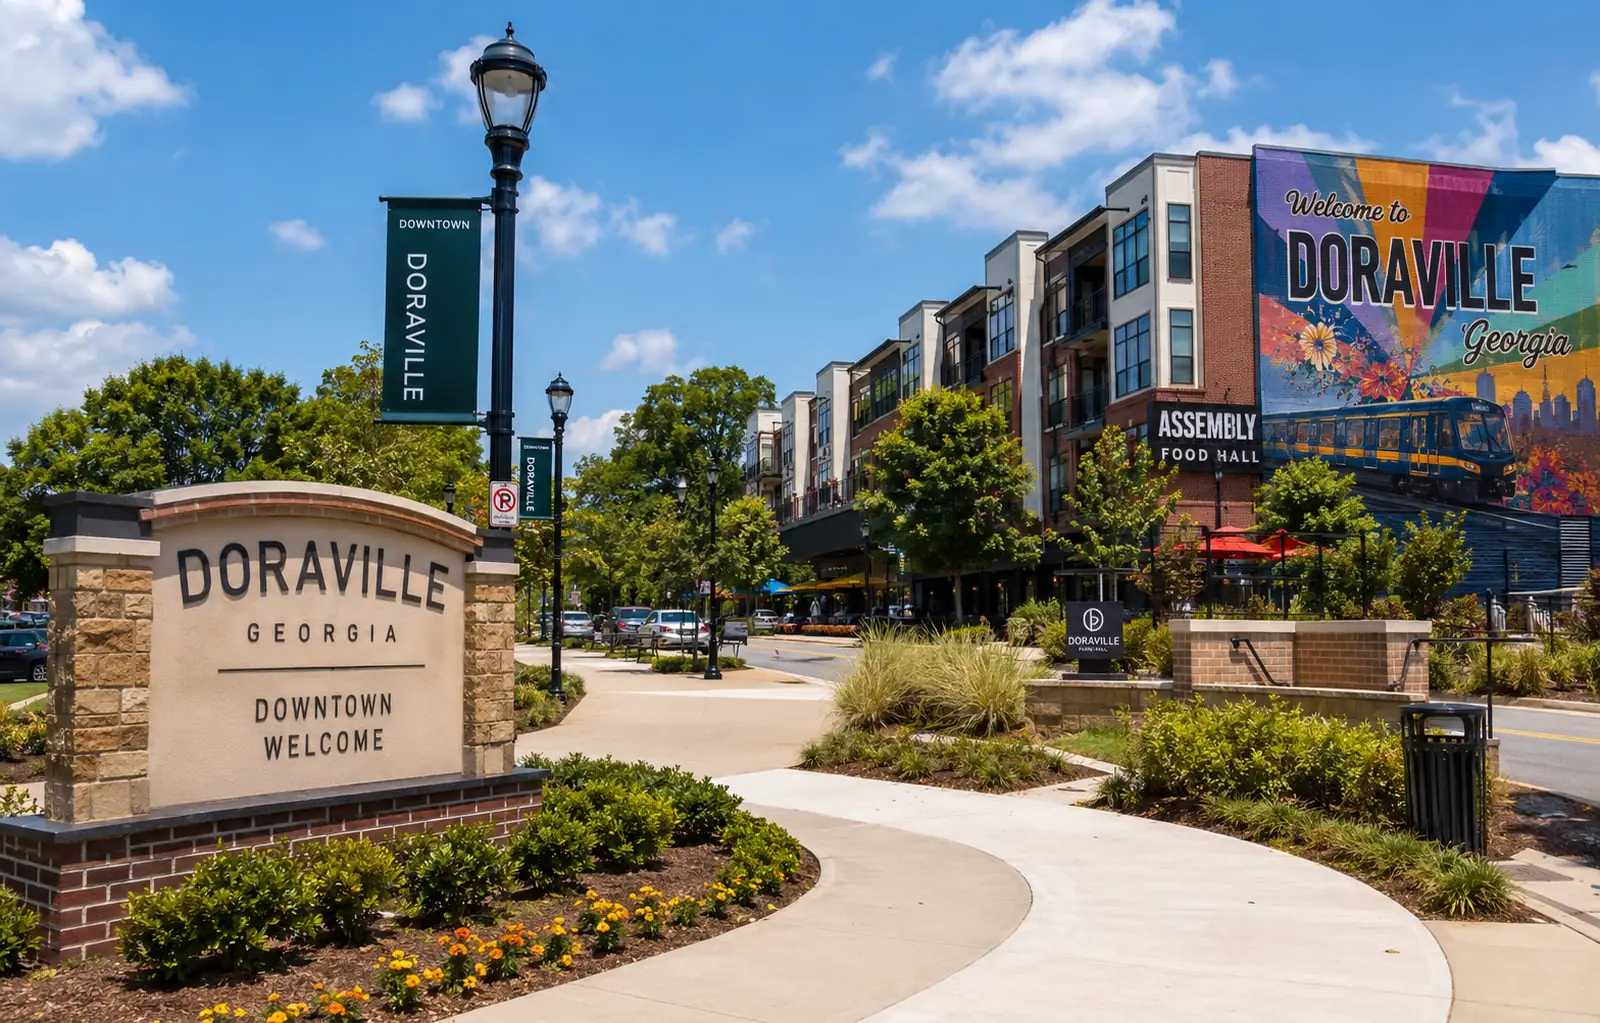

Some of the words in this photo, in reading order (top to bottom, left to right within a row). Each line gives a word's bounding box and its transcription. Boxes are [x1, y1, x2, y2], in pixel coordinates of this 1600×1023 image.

[1285, 189, 1384, 222] Welcome
[1388, 200, 1412, 223] to
[399, 219, 470, 229] DOWNTOWN
[1287, 229, 1538, 314] DORAVILLE
[403, 253, 427, 401] DORAVILLE
[1158, 410, 1257, 440] ASSEMBLY
[1161, 448, 1208, 461] FOOD
[1217, 450, 1260, 463] HALL
[526, 457, 535, 511] DORAVILLE
[177, 540, 449, 612] DORAVILLE
[247, 622, 397, 643] GEORGIA
[1068, 636, 1120, 646] DORAVILLE
[255, 693, 392, 723] DOWNTOWN
[264, 728, 384, 761] WELCOME
